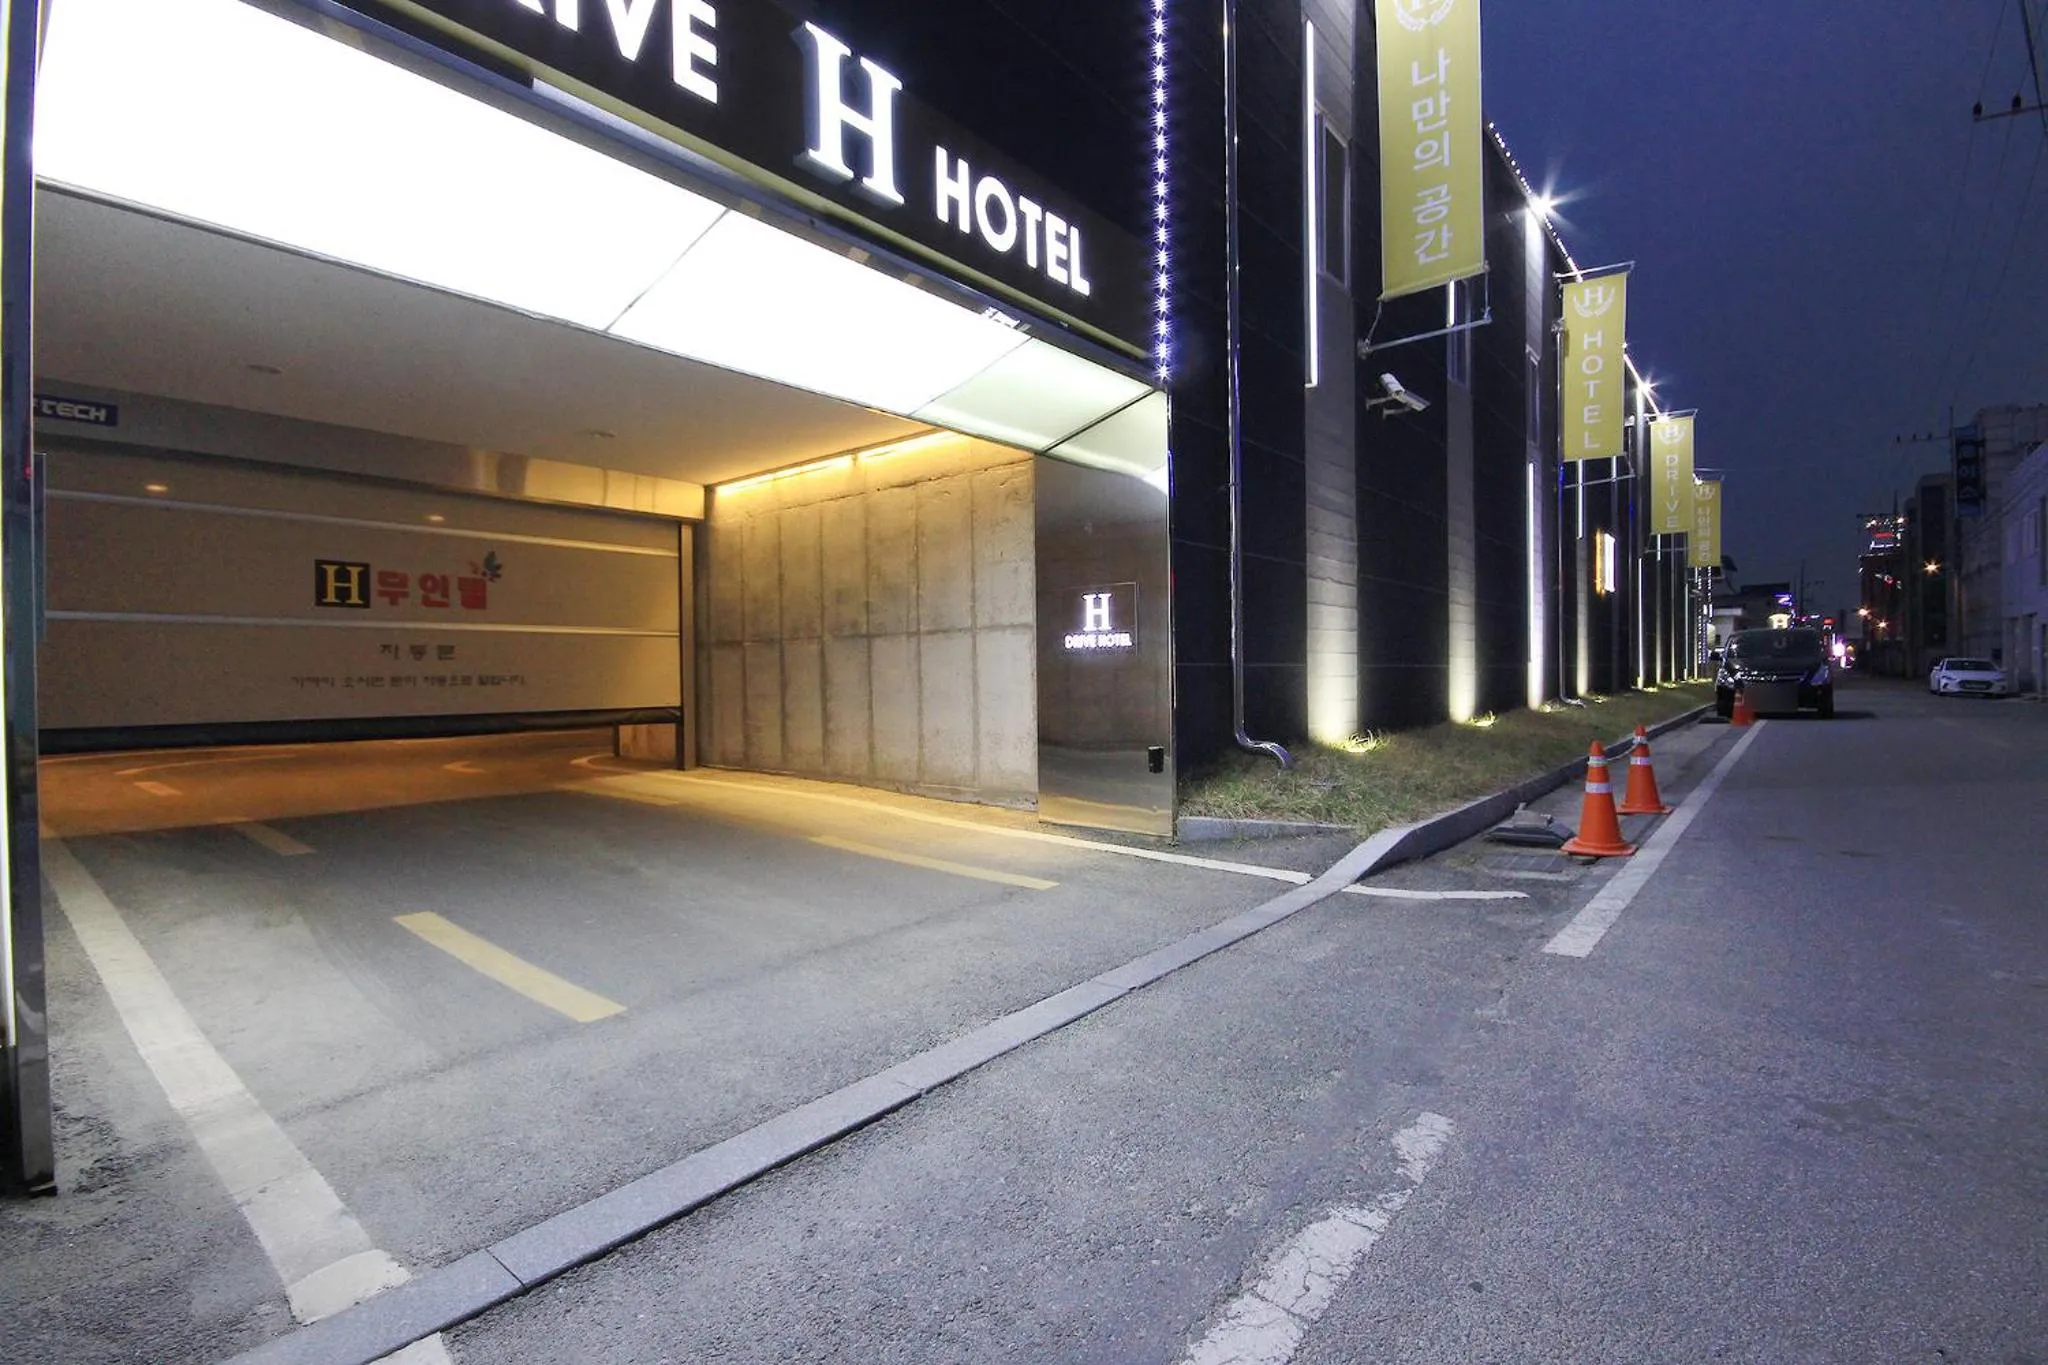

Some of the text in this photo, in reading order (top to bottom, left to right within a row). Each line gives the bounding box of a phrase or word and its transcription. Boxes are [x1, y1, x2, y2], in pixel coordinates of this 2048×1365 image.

[804, 20, 905, 204] H
[935, 144, 1091, 296] HOTEL
[1411, 47, 1453, 265] 나만의 공간
[1583, 286, 1604, 305] H
[1581, 332, 1605, 450] HOTEL
[320, 564, 365, 605] H
[1082, 593, 1112, 631] H
[1098, 632, 1133, 648] HOTEL
